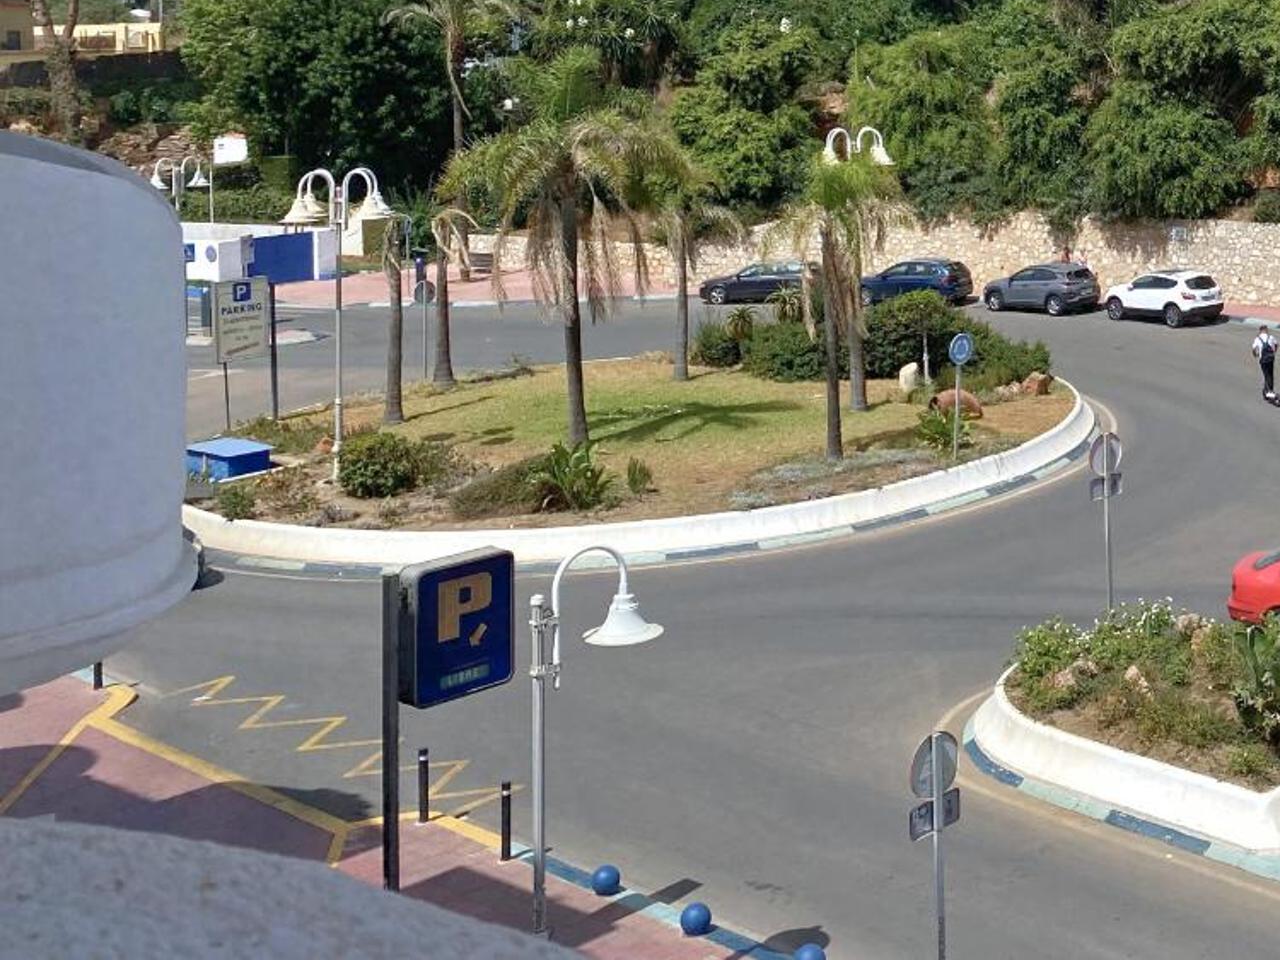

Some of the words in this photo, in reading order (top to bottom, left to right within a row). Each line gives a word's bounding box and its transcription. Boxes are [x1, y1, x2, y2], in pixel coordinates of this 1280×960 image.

[236, 285, 247, 300] P
[221, 303, 261, 315] PARKING
[438, 572, 492, 643] P
